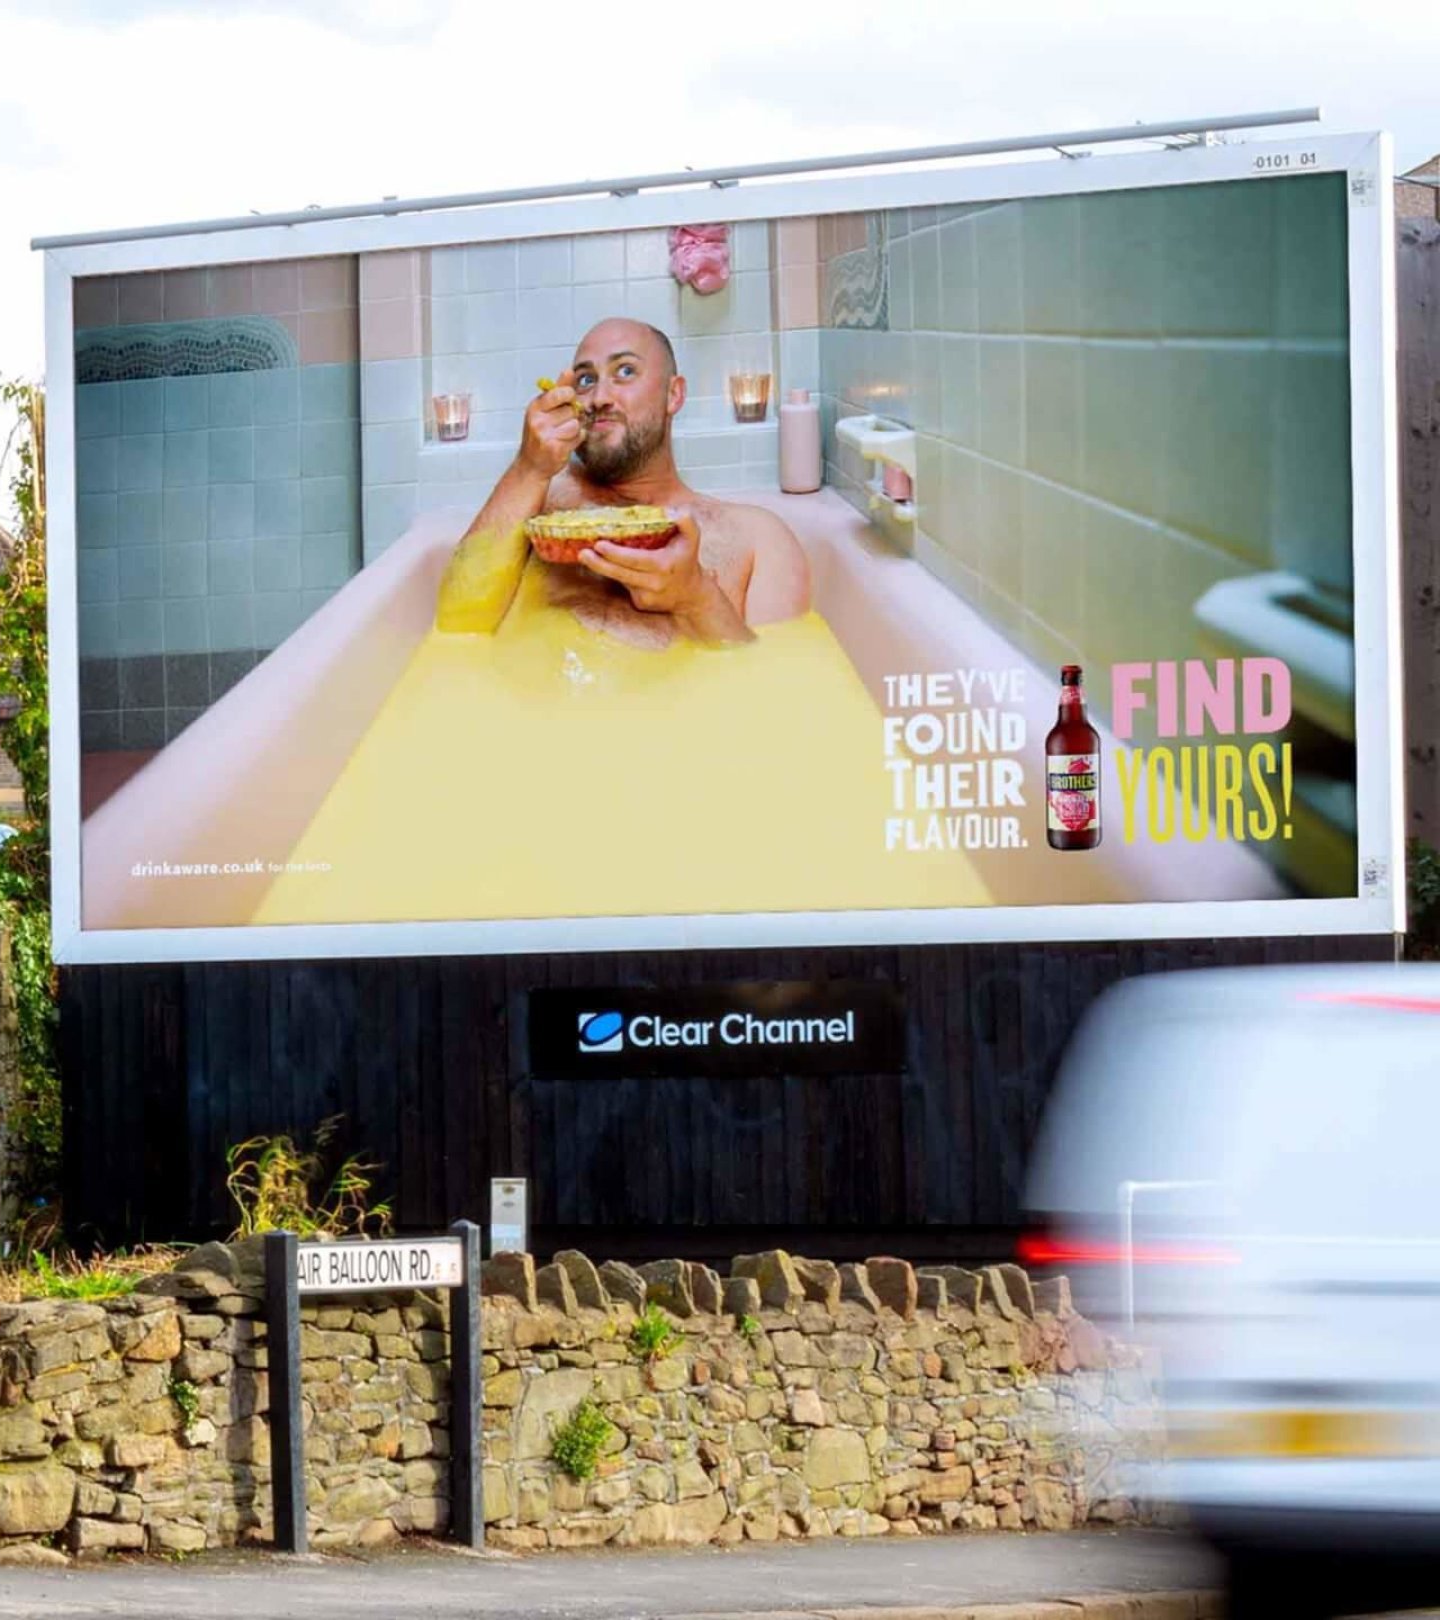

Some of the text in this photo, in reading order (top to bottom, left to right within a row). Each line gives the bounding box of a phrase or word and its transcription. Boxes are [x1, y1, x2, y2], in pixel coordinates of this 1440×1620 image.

[1256, 154, 1290, 168] 0101
[883, 668, 1025, 708] THEY'VE
[1111, 657, 1293, 740] FIND
[884, 708, 1026, 756] FOUND
[884, 759, 1026, 811] THEIR
[1115, 742, 1294, 846] YOURS!
[885, 813, 1029, 851] FLAVOUR.
[131, 859, 264, 877] drinkaware.co.uk
[628, 1010, 855, 1047] Clear Channel
[298, 1252, 323, 1286] AIR
[329, 1250, 403, 1285] BALLOON
[409, 1248, 435, 1281] RD.
